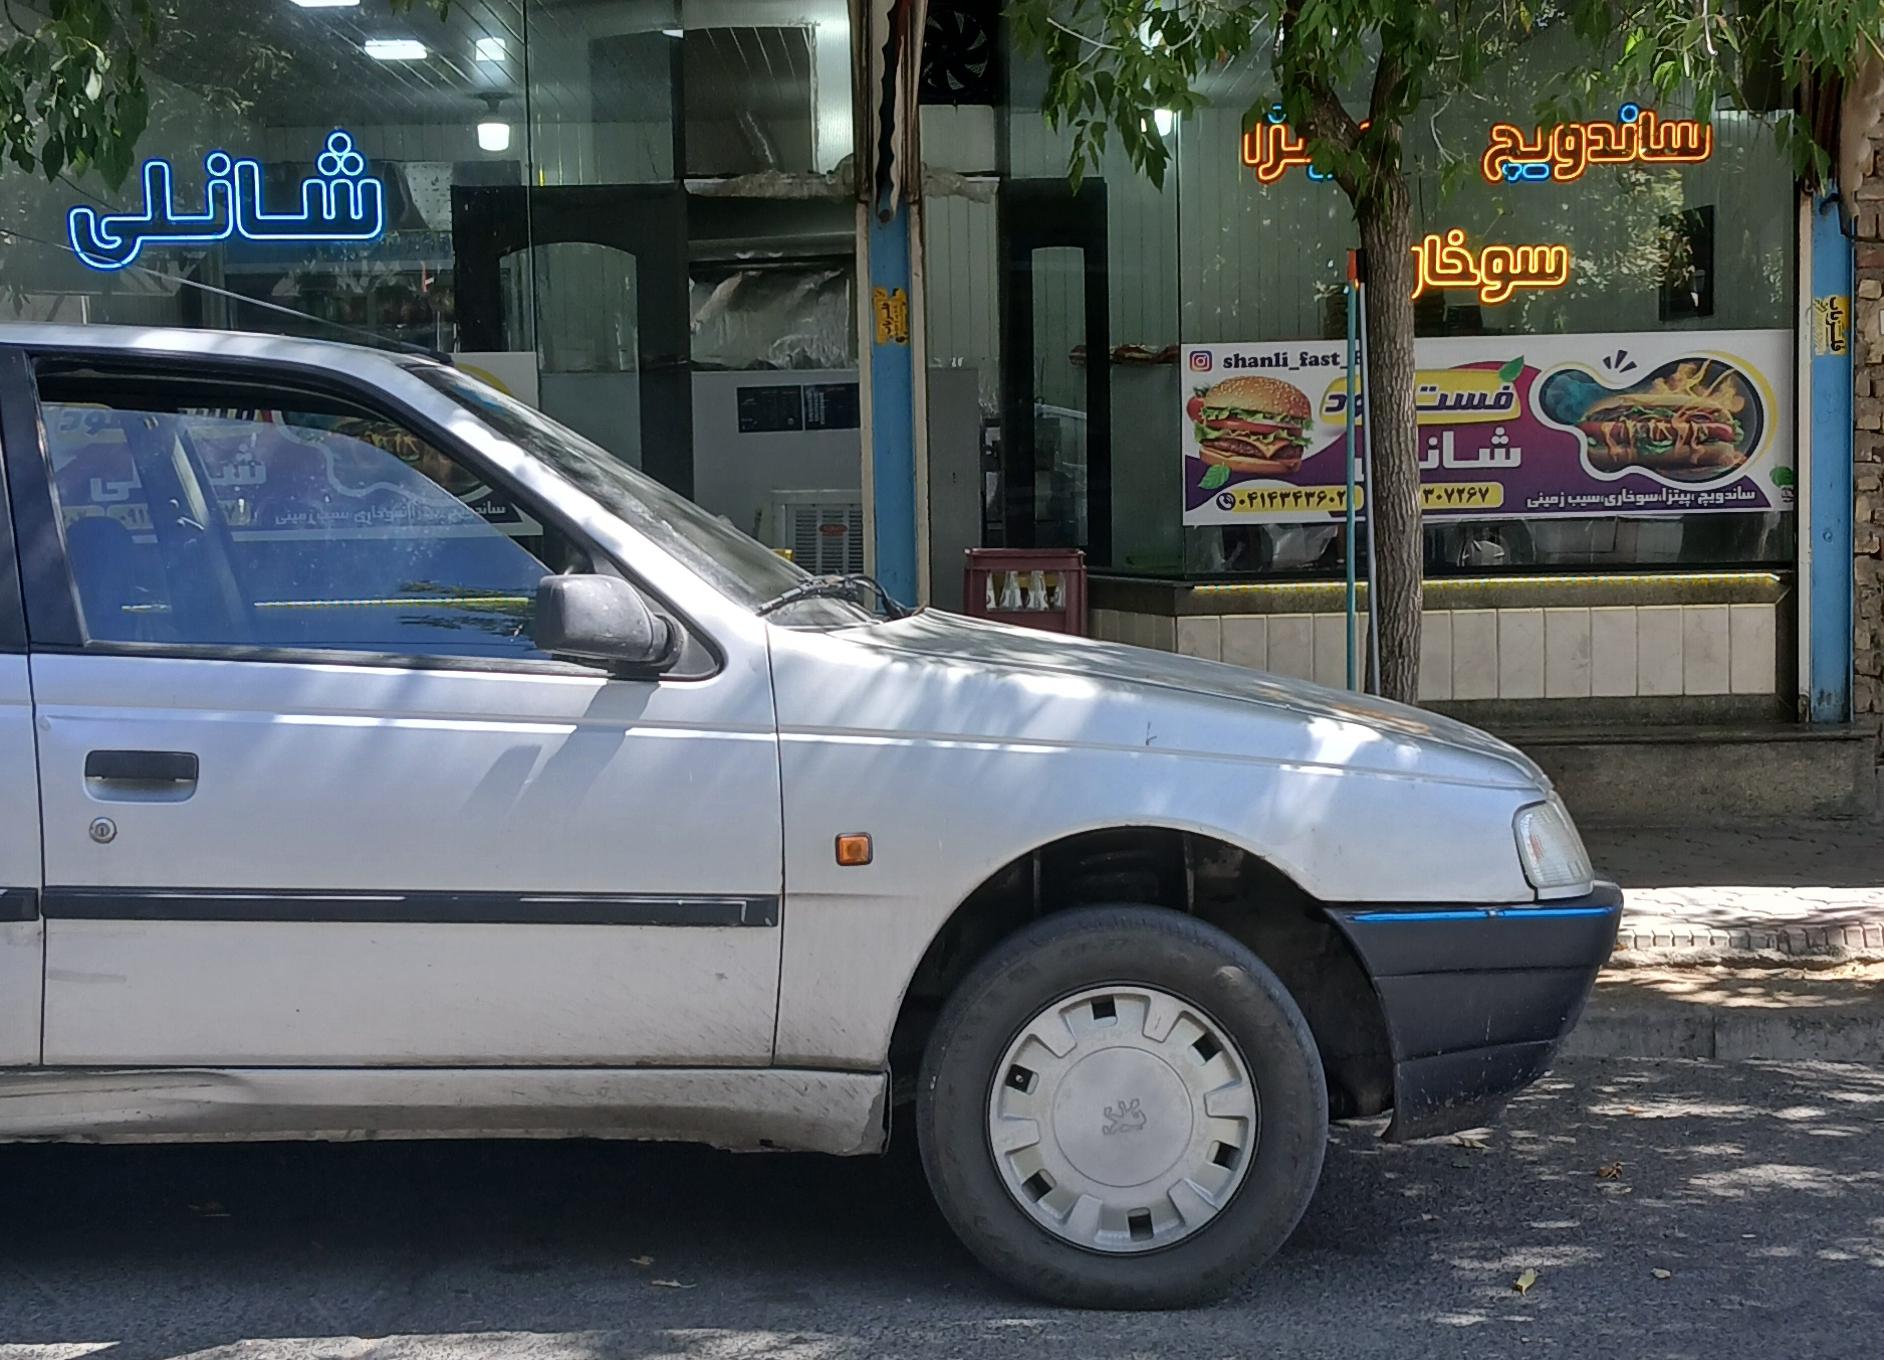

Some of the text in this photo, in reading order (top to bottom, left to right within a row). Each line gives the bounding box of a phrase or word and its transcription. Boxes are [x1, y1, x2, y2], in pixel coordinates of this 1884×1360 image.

[1483, 103, 1712, 183] ساندویچ
[69, 131, 384, 270] شانلی
[1411, 228, 1568, 304] سوخار
[1527, 491, 1565, 508] زمینی
[1698, 485, 1756, 507] ساندویچ
